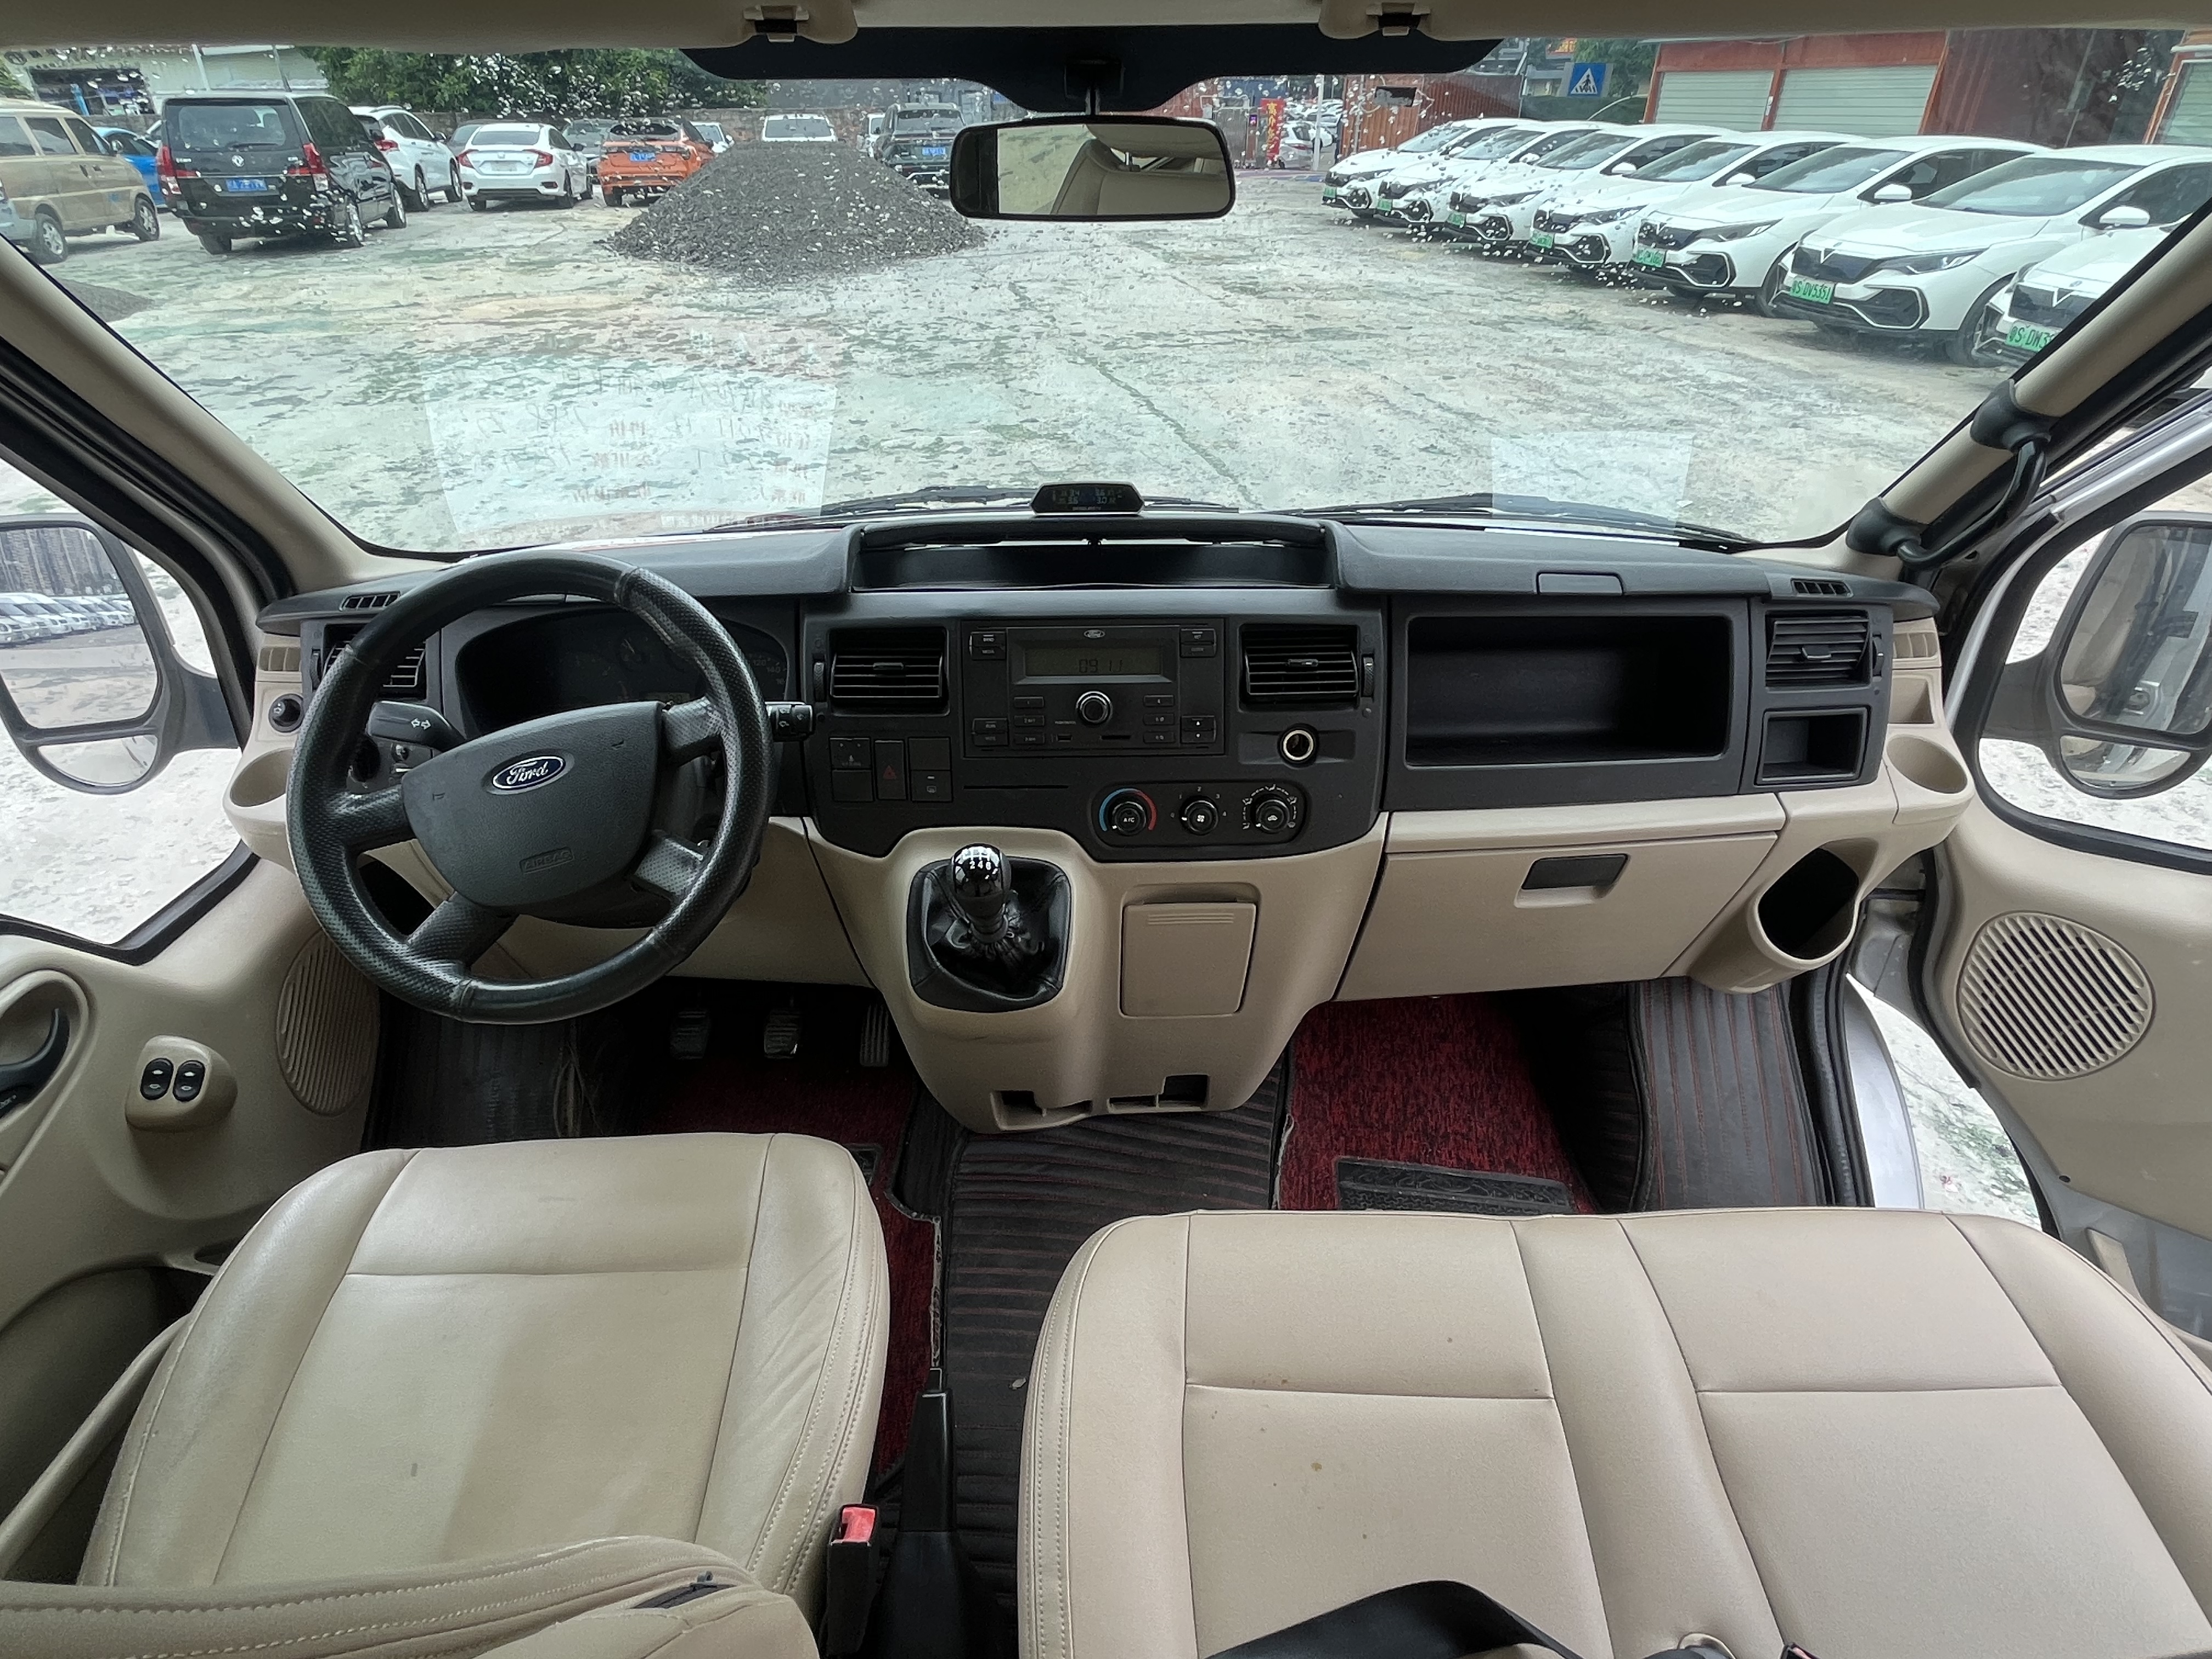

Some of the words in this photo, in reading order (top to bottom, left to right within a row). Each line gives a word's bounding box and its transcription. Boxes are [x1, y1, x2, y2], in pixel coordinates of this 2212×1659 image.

[506, 761, 549, 785] Ford
[525, 850, 571, 870] AIRBAG
[969, 860, 975, 869] 2
[978, 860, 983, 869] 4
